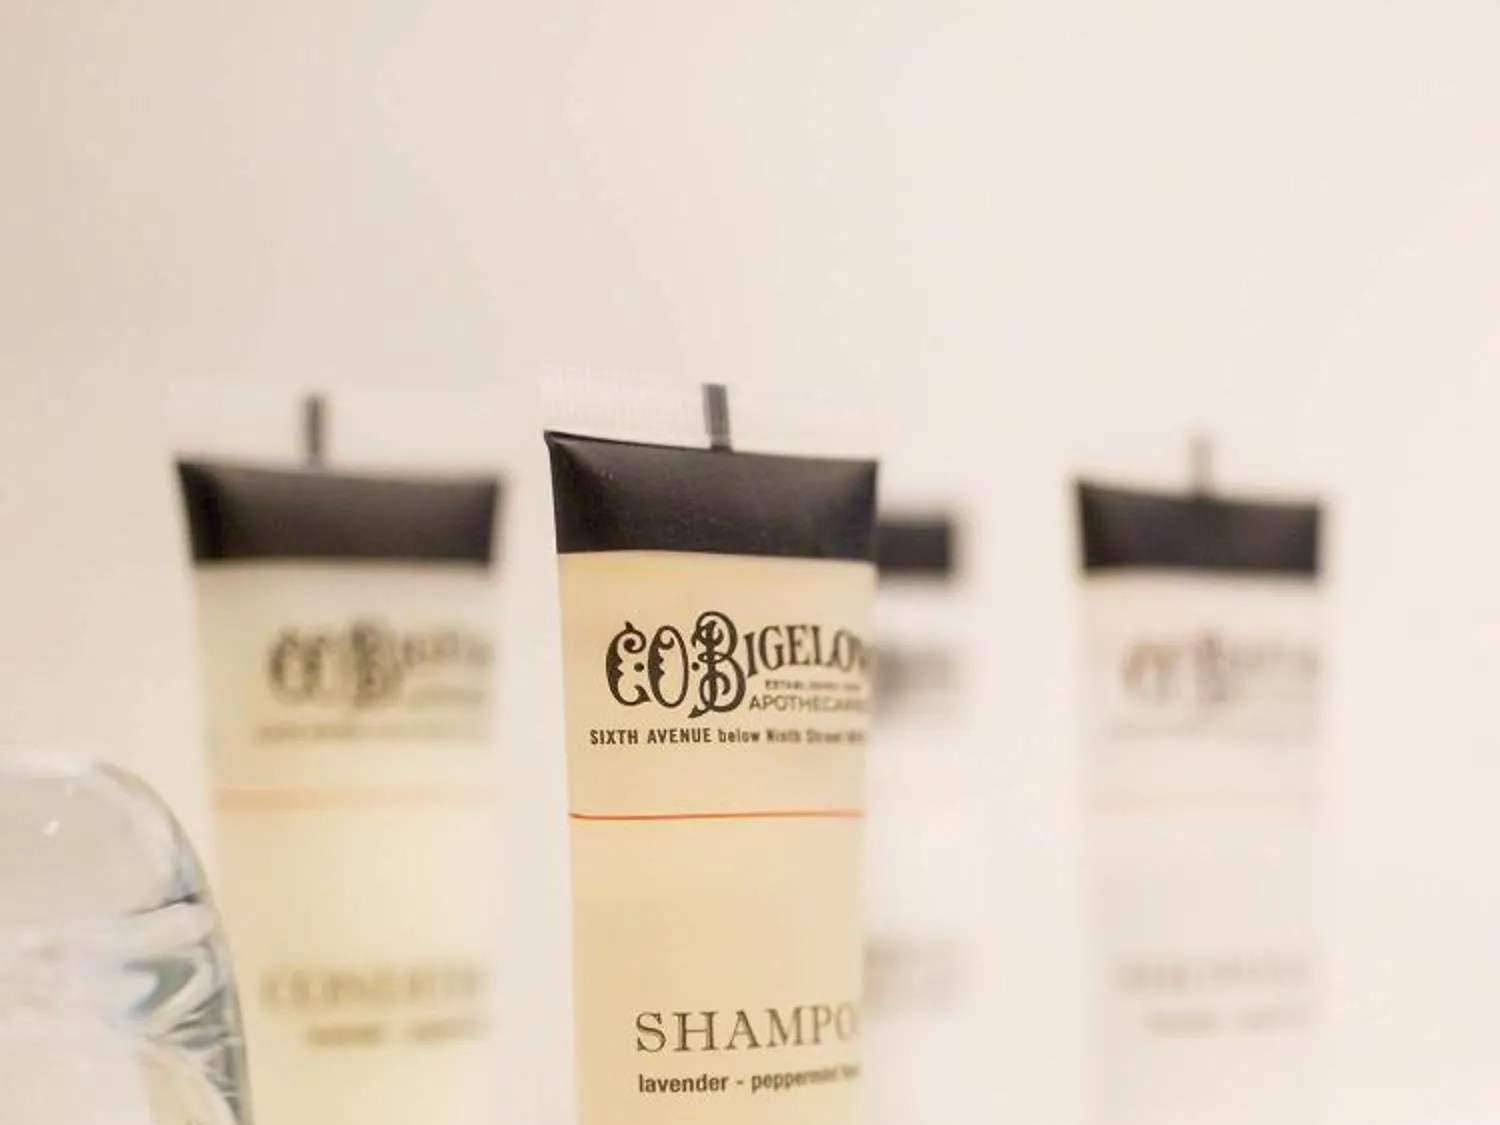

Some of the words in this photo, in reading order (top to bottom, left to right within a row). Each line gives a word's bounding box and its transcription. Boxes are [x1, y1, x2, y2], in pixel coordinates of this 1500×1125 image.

[589, 728, 639, 746] SIXTH
[647, 727, 712, 745] AVENUE
[718, 728, 760, 744] below
[638, 1073, 728, 1093] lavender
